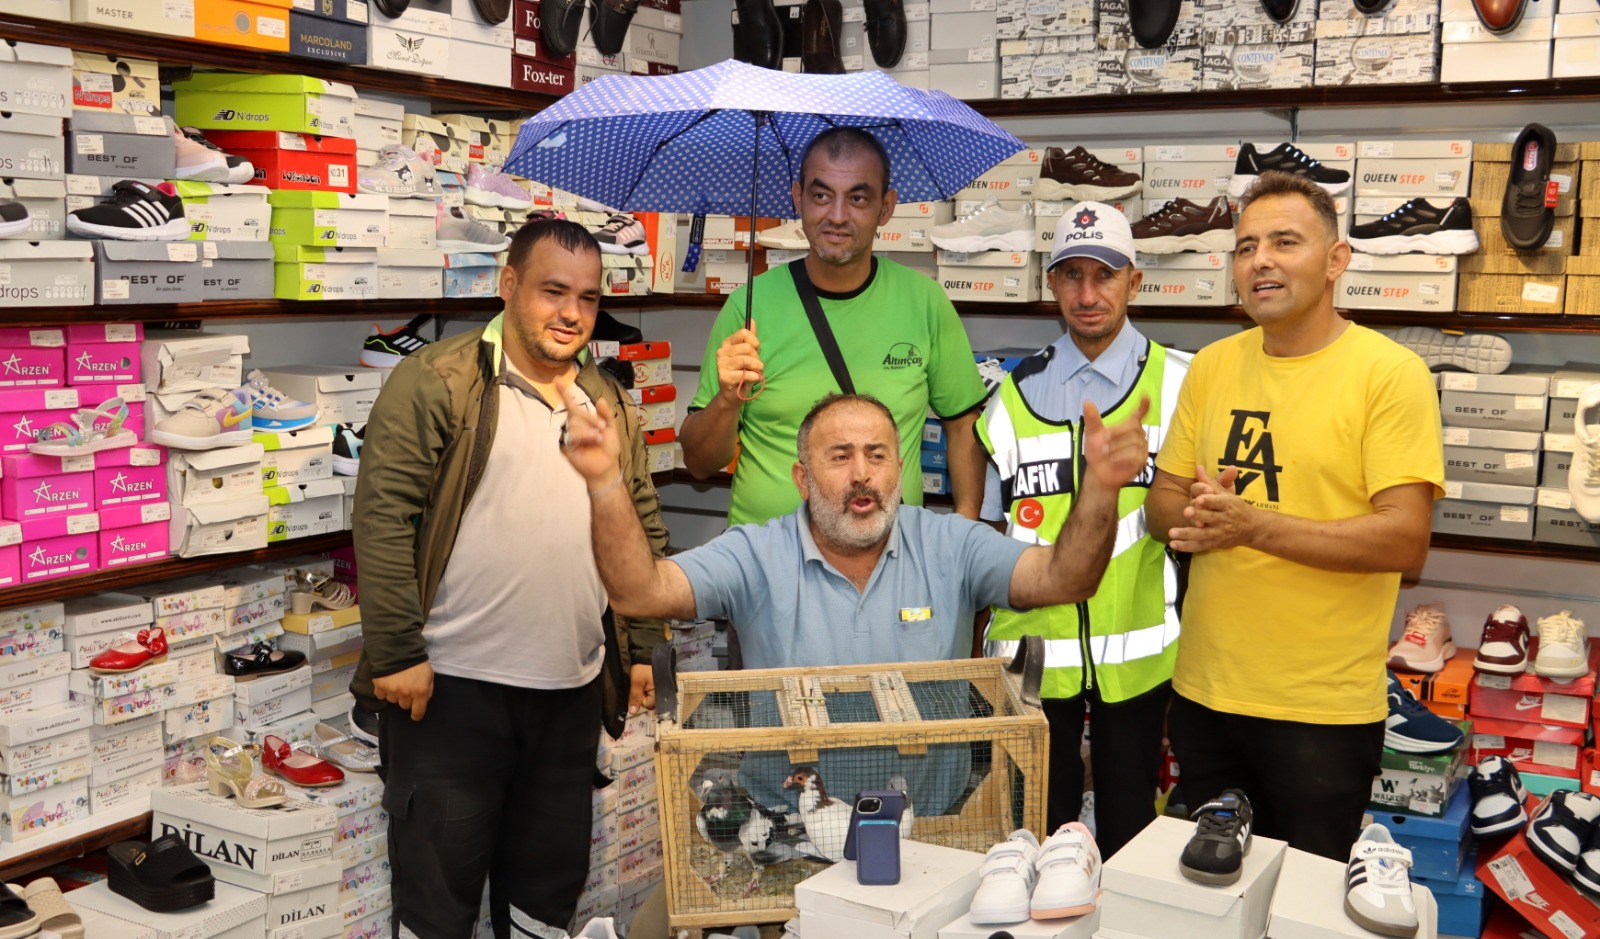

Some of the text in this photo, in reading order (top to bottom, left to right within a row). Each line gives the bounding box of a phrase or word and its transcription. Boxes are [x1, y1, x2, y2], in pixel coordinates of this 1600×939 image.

[96, 6, 134, 20] MASTER
[300, 33, 352, 51] MARCOLAND
[308, 47, 346, 58] EXCLUSIVE
[522, 64, 564, 86] Fox-ter
[237, 112, 270, 122] N'drops
[88, 154, 116, 162] BEST
[1150, 178, 1206, 188] QUEEN STEP
[1364, 173, 1424, 184] QUEEN STEP
[990, 182, 1010, 190] STEP
[882, 232, 902, 241] STEP
[166, 276, 184, 284] OF
[944, 280, 994, 291] QUEEN STEP
[0, 284, 38, 301] drops
[1163, 285, 1184, 294] STEP
[1346, 286, 1408, 297] QUEEN STEP
[2, 353, 50, 375] ARZEN
[75, 350, 117, 371] ARZEN
[1455, 406, 1484, 415] BEST
[1448, 460, 1477, 468] BEST
[110, 472, 154, 494] ARZEN
[33, 480, 80, 504] ARZEN
[1443, 511, 1496, 522] BEST OF
[1550, 518, 1582, 528] BEST
[110, 534, 148, 554] ARZEN
[28, 545, 72, 568] ARZEN
[272, 850, 300, 862] DİLAN
[1378, 848, 1404, 856] adidas
[280, 904, 326, 924] DİLAN
